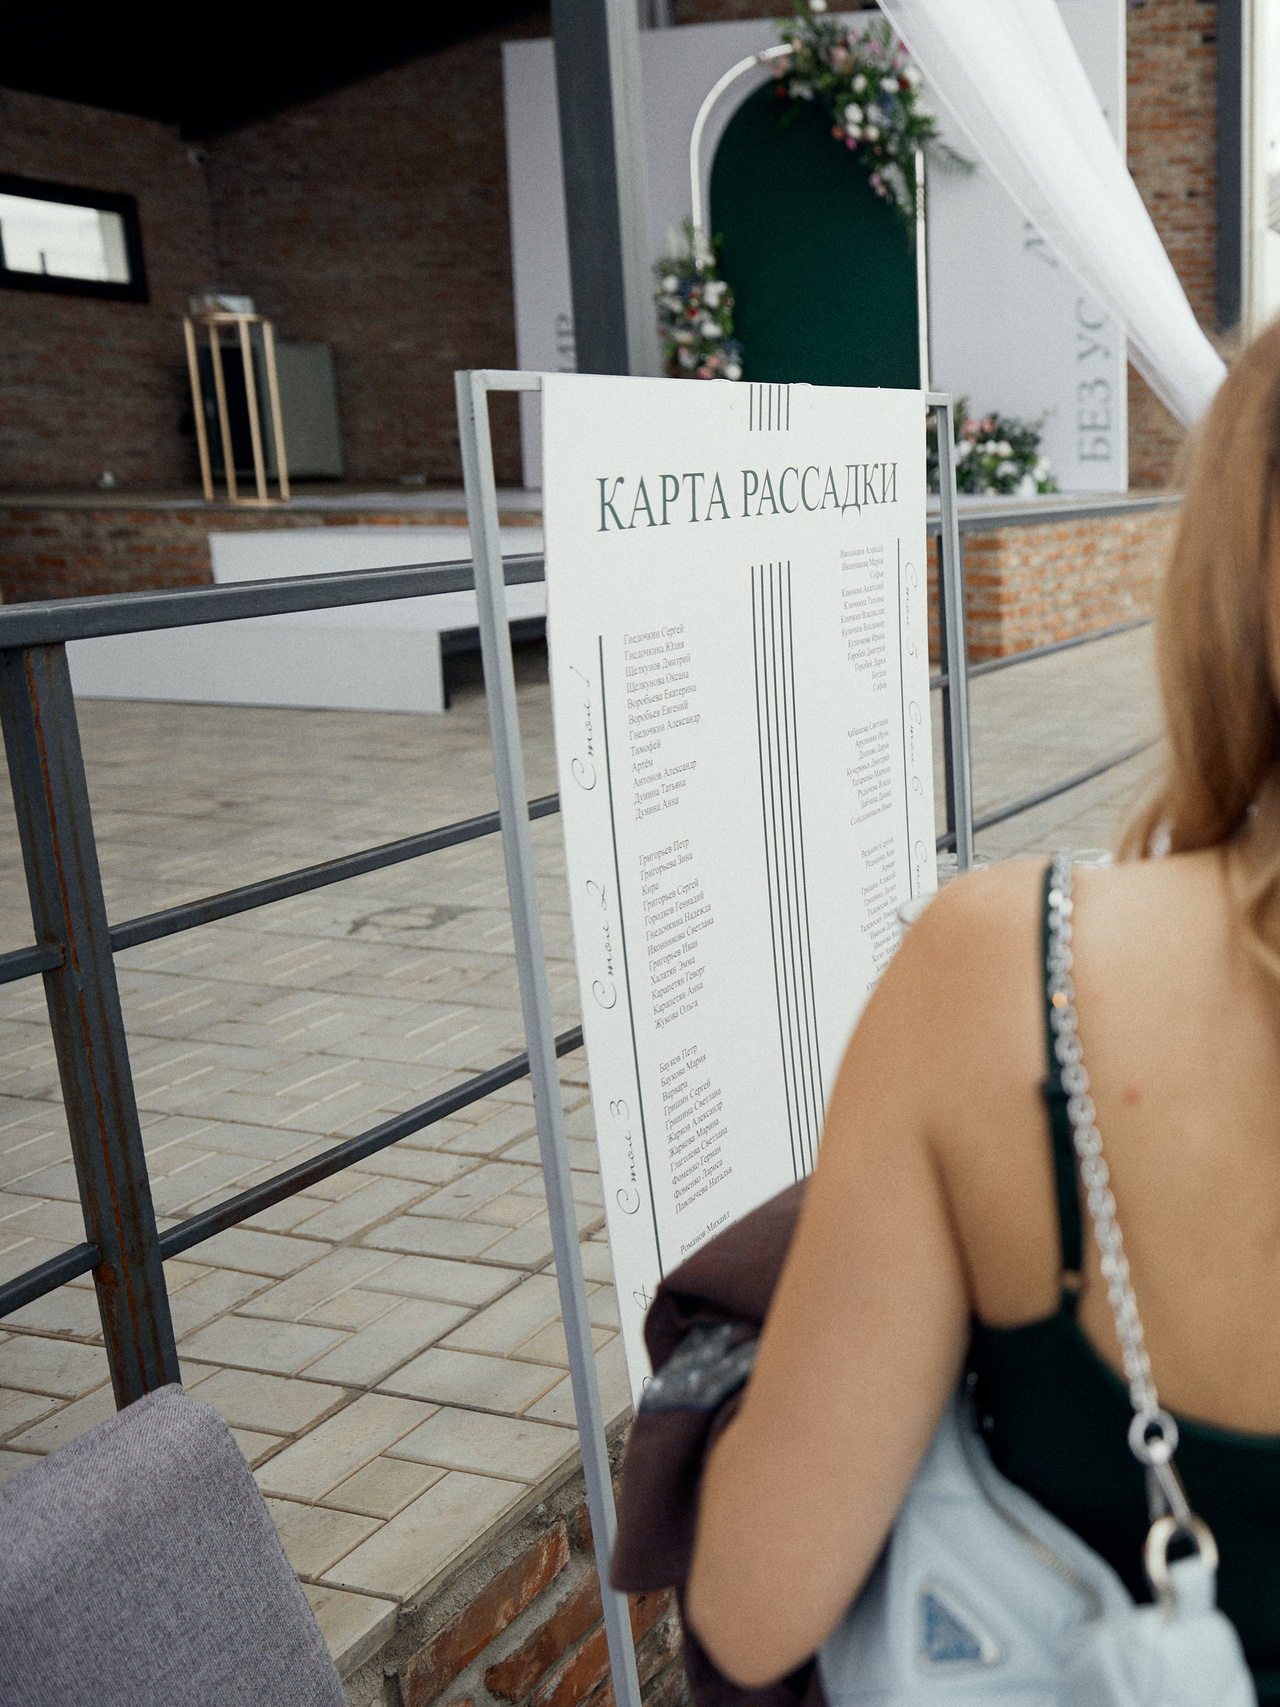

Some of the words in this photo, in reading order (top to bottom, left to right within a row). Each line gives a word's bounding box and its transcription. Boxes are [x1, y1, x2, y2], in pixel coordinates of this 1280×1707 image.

[596, 471, 731, 532] КАРТА
[740, 462, 898, 519] РАССАДКИ
[865, 544, 883, 555] Алексей
[869, 558, 884, 568] Мария
[867, 595, 884, 605] Татьяна
[661, 624, 684, 638] Сергей
[665, 640, 684, 653] Юлия
[866, 644, 886, 656] Дмитрий
[626, 662, 660, 677] Щелкунов
[662, 653, 691, 669] Дмитрий
[626, 677, 664, 693] Щелкунова
[666, 671, 689, 684] Оксана
[627, 693, 663, 709] Воробьева
[664, 684, 697, 699] Екатерина
[628, 709, 660, 725] Воробьев
[662, 700, 689, 715] Евгений
[666, 714, 700, 729] Александр
[571, 697, 597, 790] Стол
[631, 740, 661, 756] Тимофей
[632, 759, 654, 773] Артём
[633, 773, 661, 788] Антонов
[664, 760, 697, 777] Александр
[634, 790, 660, 805] Дунина
[661, 779, 686, 794] Татьяна
[635, 805, 661, 820] Дунина
[662, 797, 679, 809] Анна
[639, 847, 672, 866] Григорьев
[673, 839, 690, 852] Петр
[640, 860, 677, 881] Григорьева
[678, 852, 693, 865] Зина
[586, 880, 608, 910] 2
[642, 882, 659, 896] Кира
[643, 890, 676, 911] Григорьев
[677, 878, 699, 895] Сергей
[675, 891, 704, 911] Геннадий
[685, 904, 711, 923] Надежда
[647, 931, 686, 956] Иконникова
[686, 917, 714, 936] Светлана
[592, 920, 617, 1009] Стол
[649, 950, 681, 971] Григорьев
[682, 940, 698, 954] Иван
[651, 977, 685, 1000] Карапетян
[686, 965, 706, 982] Геворг
[653, 992, 686, 1015] Карапетян
[687, 982, 704, 997] Анна
[655, 1010, 679, 1030] Жукова
[680, 999, 699, 1015] Ольга
[681, 1045, 698, 1059] Петр
[686, 1053, 707, 1071] Мария
[662, 1080, 688, 1102] Варвара
[663, 1095, 689, 1117] Гришин
[689, 1078, 711, 1099] Сергей
[610, 1099, 629, 1123] 3
[665, 1107, 693, 1130] Гришина
[694, 1088, 722, 1111] Светлана
[667, 1123, 691, 1144] Жарков
[692, 1101, 723, 1128] Александр
[669, 1135, 696, 1158] Жаркова
[696, 1118, 720, 1139] Марина
[670, 1148, 700, 1173] Глаголева
[700, 1127, 728, 1150] Светлана
[616, 1130, 640, 1215] Стол
[672, 1162, 699, 1185] Фоменко
[700, 1145, 721, 1166] Герман
[708, 1166, 733, 1189] Наталья
[673, 1175, 701, 1199] Фоменко
[702, 1159, 723, 1180] Лариса
[680, 1230, 706, 1255] Романов
[707, 1211, 730, 1233] Михаил
